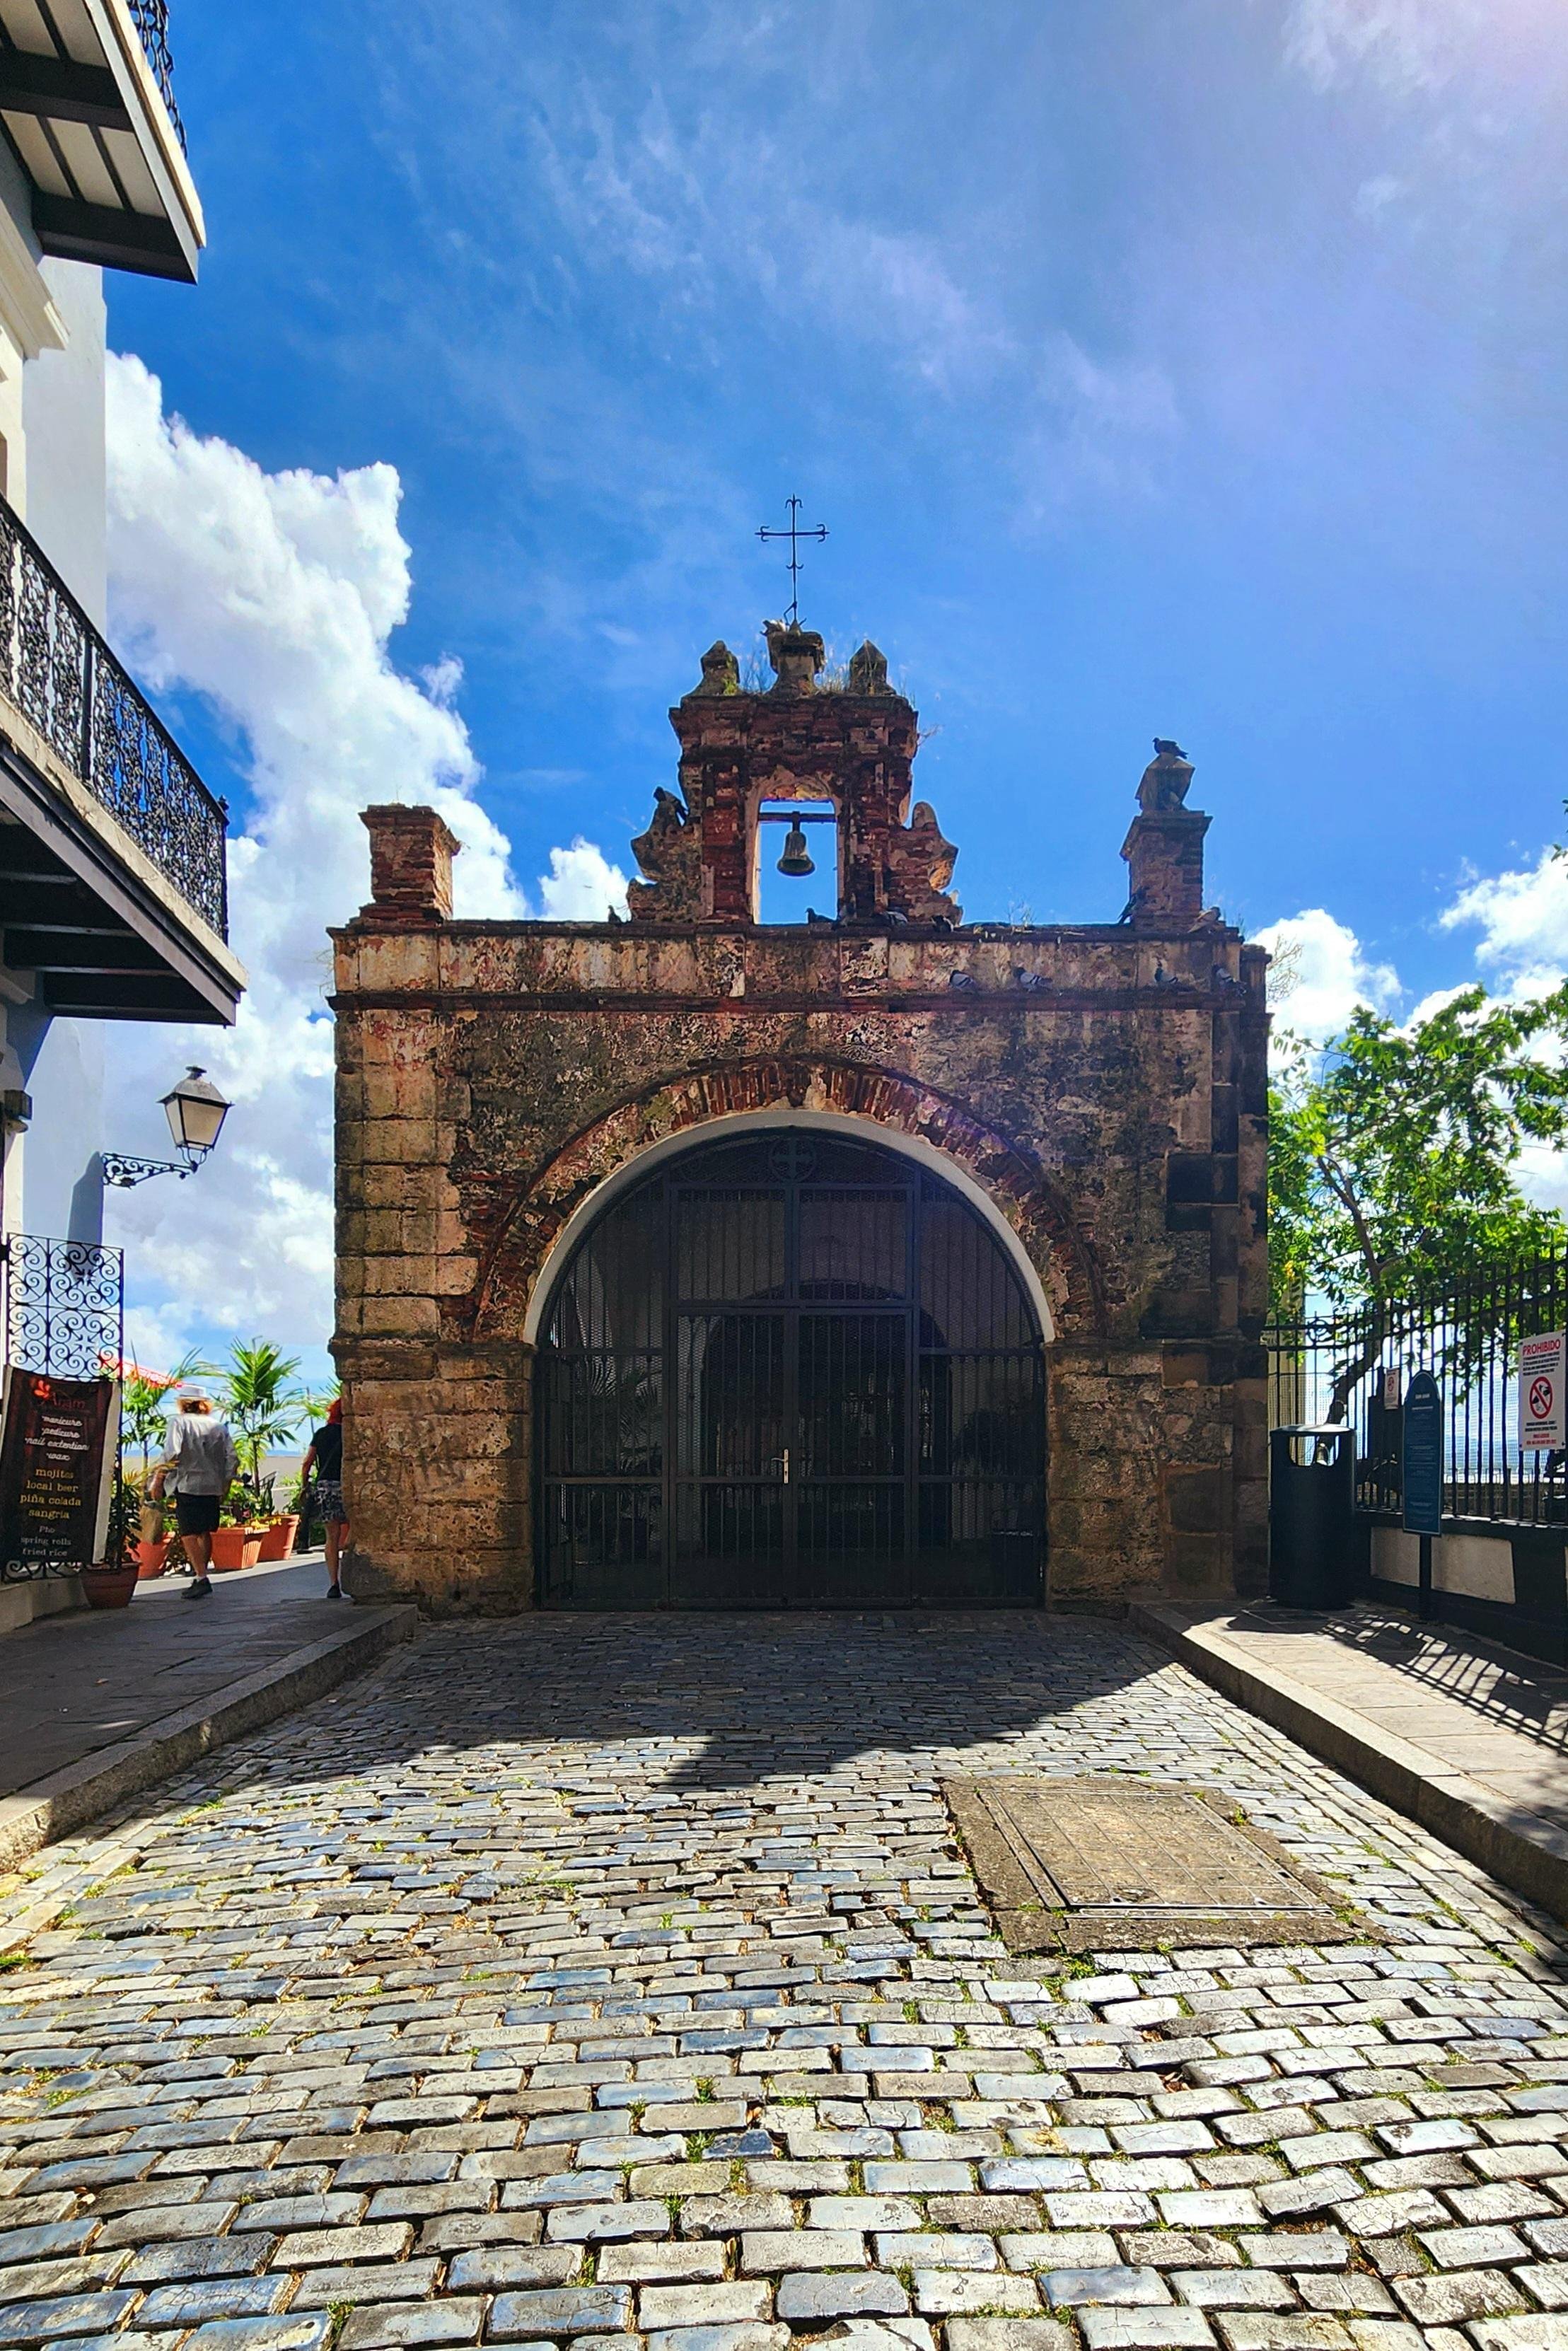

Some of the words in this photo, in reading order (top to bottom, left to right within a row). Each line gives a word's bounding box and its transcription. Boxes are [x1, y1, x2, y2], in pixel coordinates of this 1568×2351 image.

[1522, 1338, 1561, 1356] PROHIBIDO
[42, 1416, 82, 1427] manicure
[42, 1428, 80, 1439] pedicure
[25, 1436, 45, 1446] nail
[46, 1452, 70, 1461] wax
[35, 1468, 74, 1479] mojitos
[26, 1480, 52, 1491] local
[57, 1482, 79, 1492] beer
[20, 1494, 45, 1504] piña
[48, 1497, 81, 1506] colada
[28, 1509, 69, 1520] sangria
[39, 1525, 55, 1533] Pho
[21, 1536, 49, 1545] spring
[22, 1548, 46, 1556] fried
